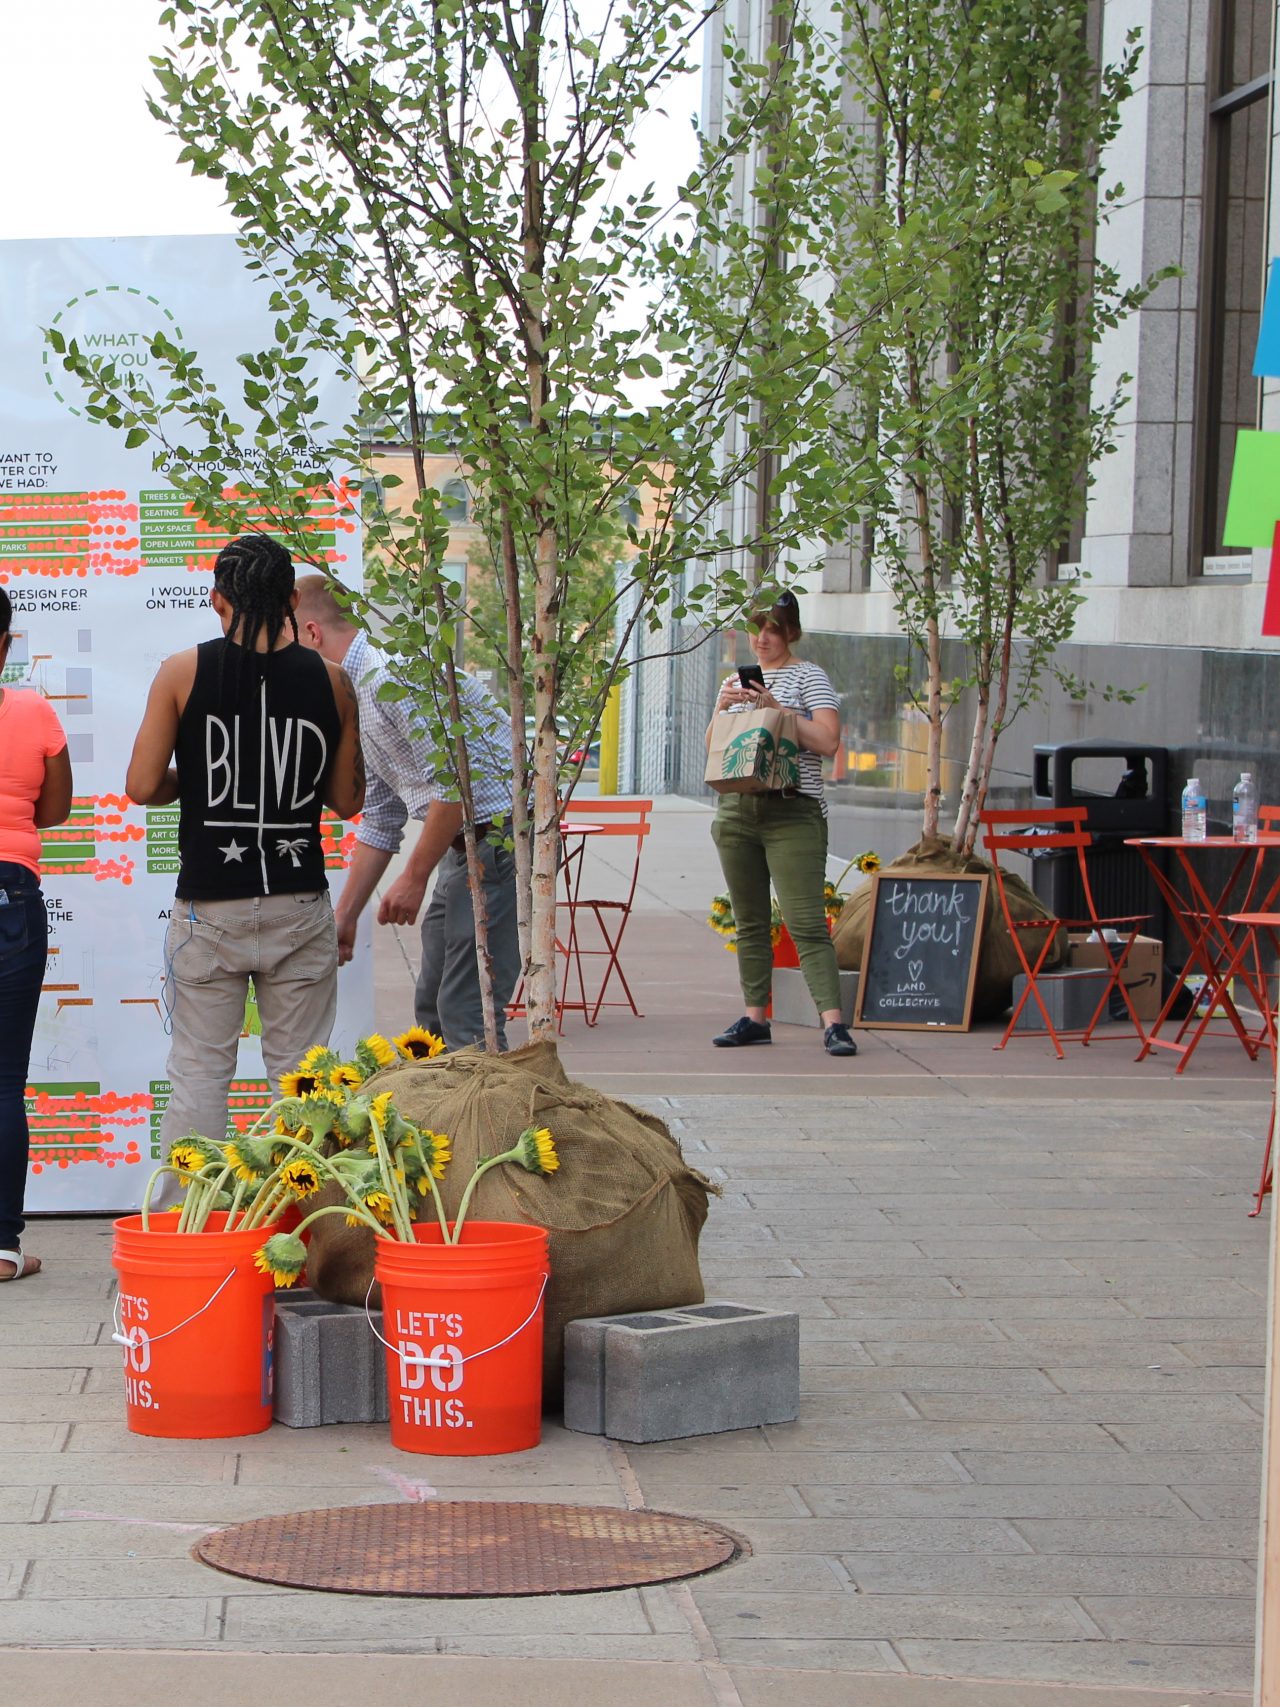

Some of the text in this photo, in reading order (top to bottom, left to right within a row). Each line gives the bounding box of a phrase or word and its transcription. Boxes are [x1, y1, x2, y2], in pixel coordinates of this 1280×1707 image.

[83, 333, 140, 347] WHAT
[109, 353, 148, 367] YOU
[34, 453, 53, 463] TO
[28, 465, 58, 475] CITY
[16, 478, 49, 489] HAD:
[144, 493, 169, 501] TREES
[144, 509, 179, 517] SEATING
[144, 524, 192, 533] PLAY SPACE
[0, 543, 27, 551] PARKS
[145, 539, 195, 548] OPEN LAWN
[145, 556, 184, 564] MARKETS
[9, 589, 58, 600] DESIGN
[61, 588, 89, 599] FOR
[158, 586, 209, 597] WOULD
[11, 602, 37, 612] HAD
[41, 601, 81, 612] MORE:
[145, 599, 166, 609] ON
[169, 598, 195, 609] THE
[206, 714, 328, 811] BLVD
[151, 831, 167, 839] ART
[151, 847, 177, 855] MORE
[885, 882, 970, 923] thank
[894, 920, 961, 959] you!
[897, 982, 926, 993] LAND
[878, 997, 941, 1008] COLLECTIVE
[120, 1292, 149, 1321] ET'S
[396, 1309, 463, 1339] LET'S
[399, 1342, 464, 1393] DO
[400, 1395, 473, 1428] THIS.
